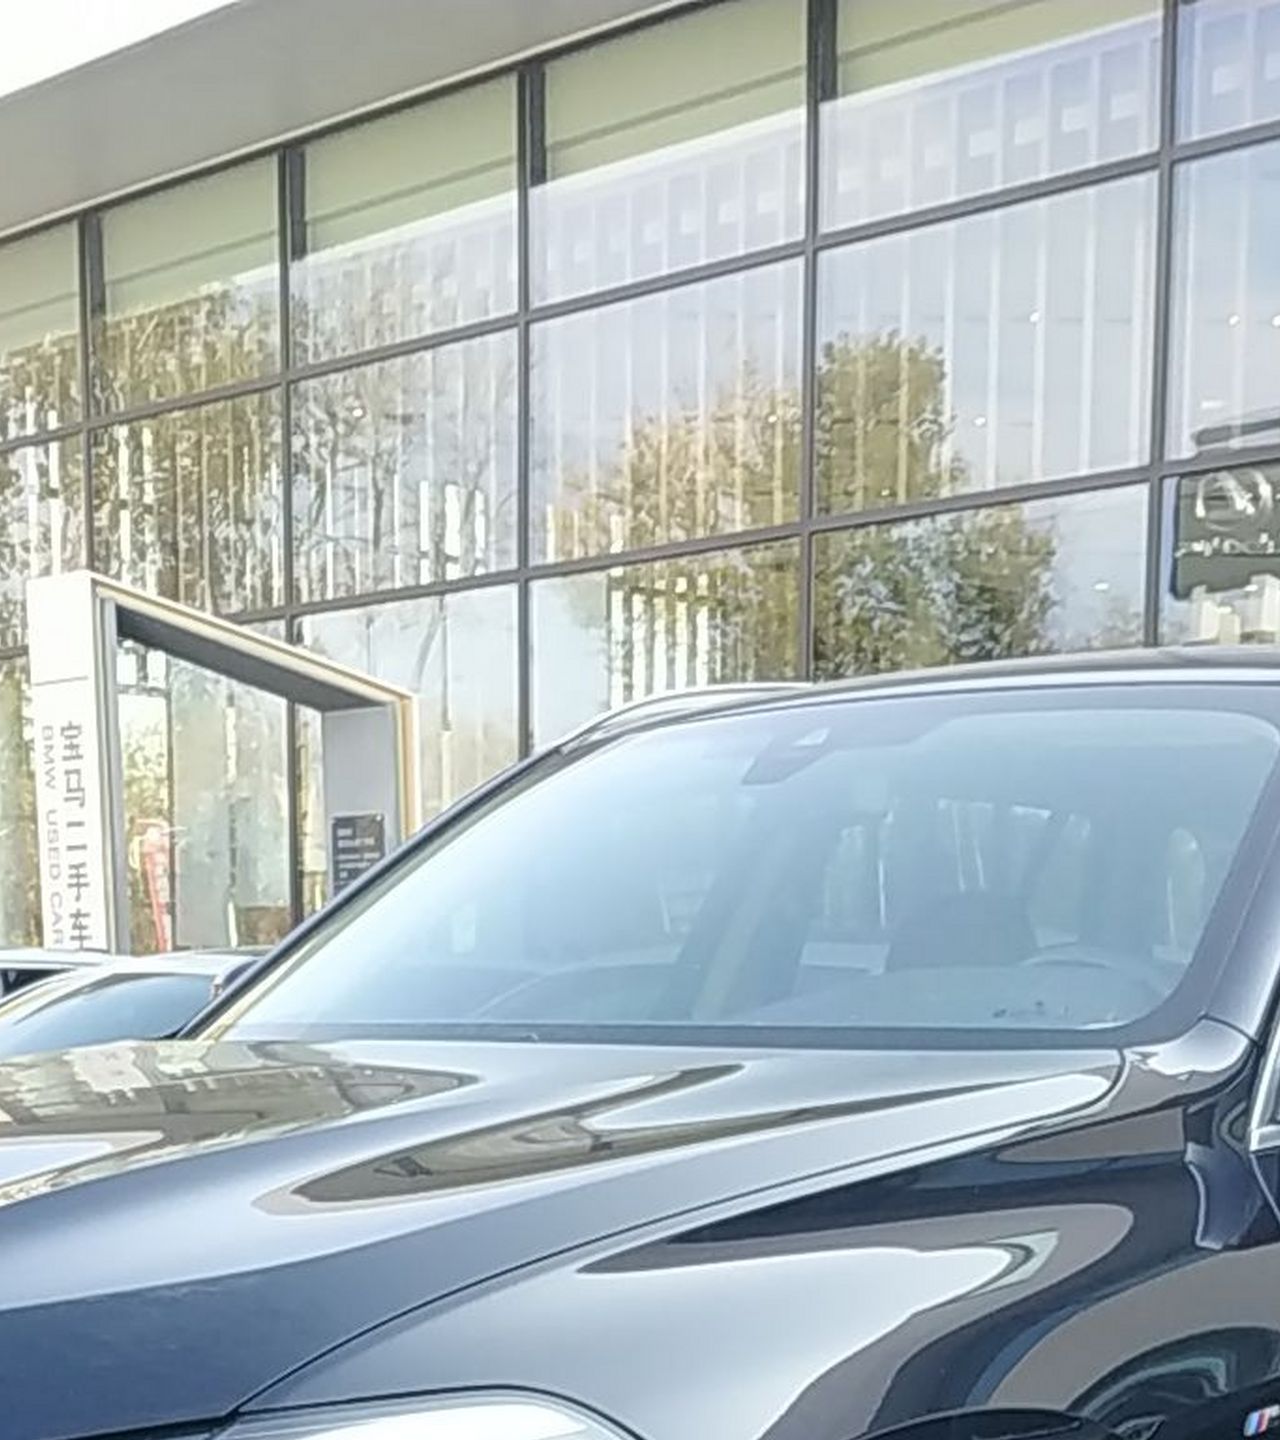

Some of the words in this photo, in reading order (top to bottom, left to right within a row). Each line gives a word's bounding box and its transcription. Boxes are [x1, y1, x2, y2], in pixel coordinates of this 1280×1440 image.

[41, 725, 57, 790] BMW
[45, 809, 62, 881] USED
[60, 720, 93, 950] 宝马二手车
[50, 891, 64, 946] CAR
